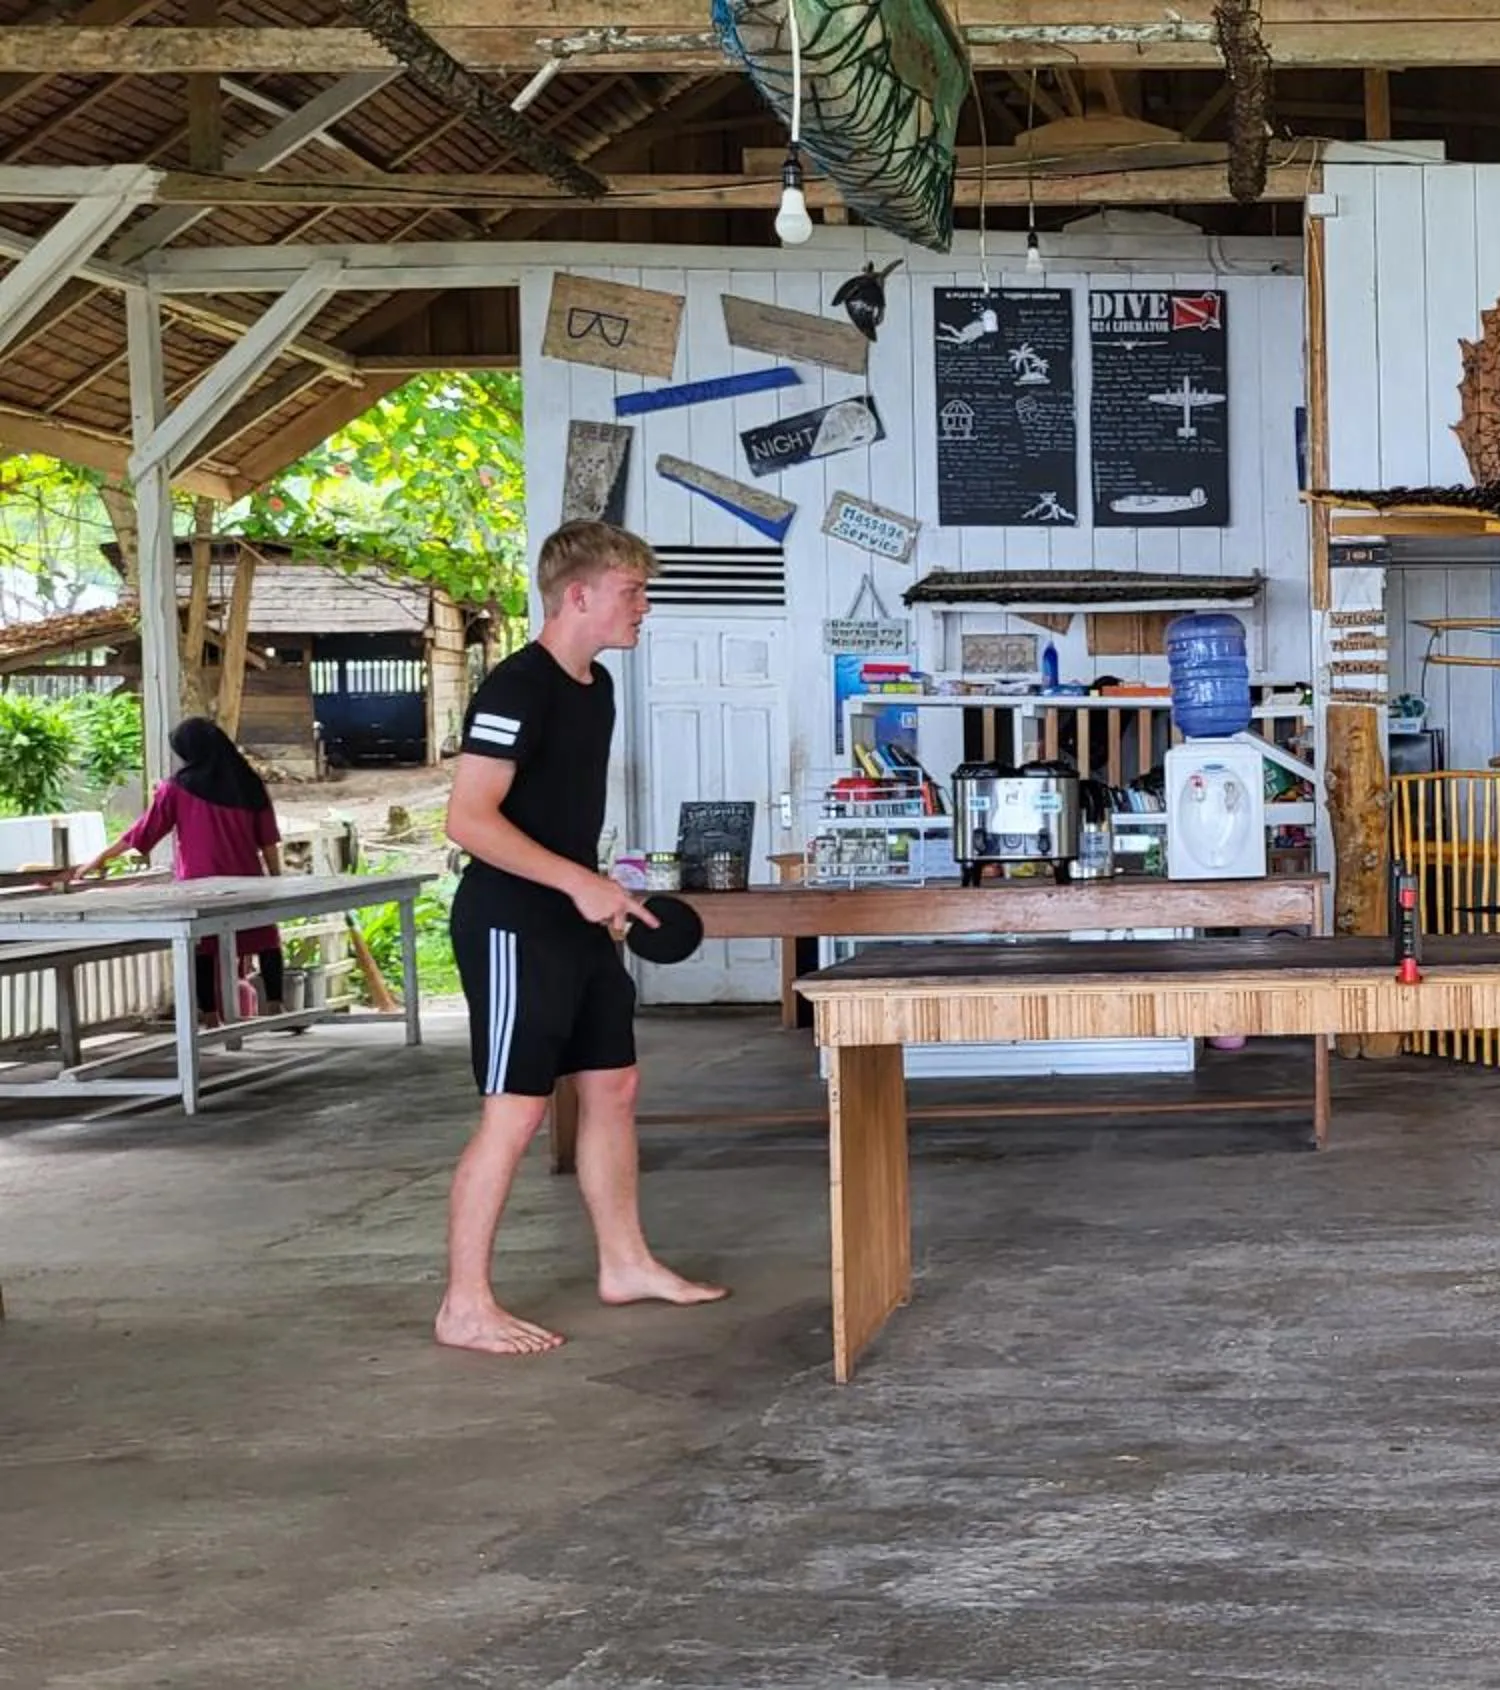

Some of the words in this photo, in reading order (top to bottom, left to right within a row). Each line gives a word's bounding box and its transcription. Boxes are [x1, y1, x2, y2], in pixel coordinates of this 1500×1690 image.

[1091, 293, 1169, 319] DIVE
[1113, 320, 1169, 333] LIBERATOR
[750, 426, 816, 461] NIGHT
